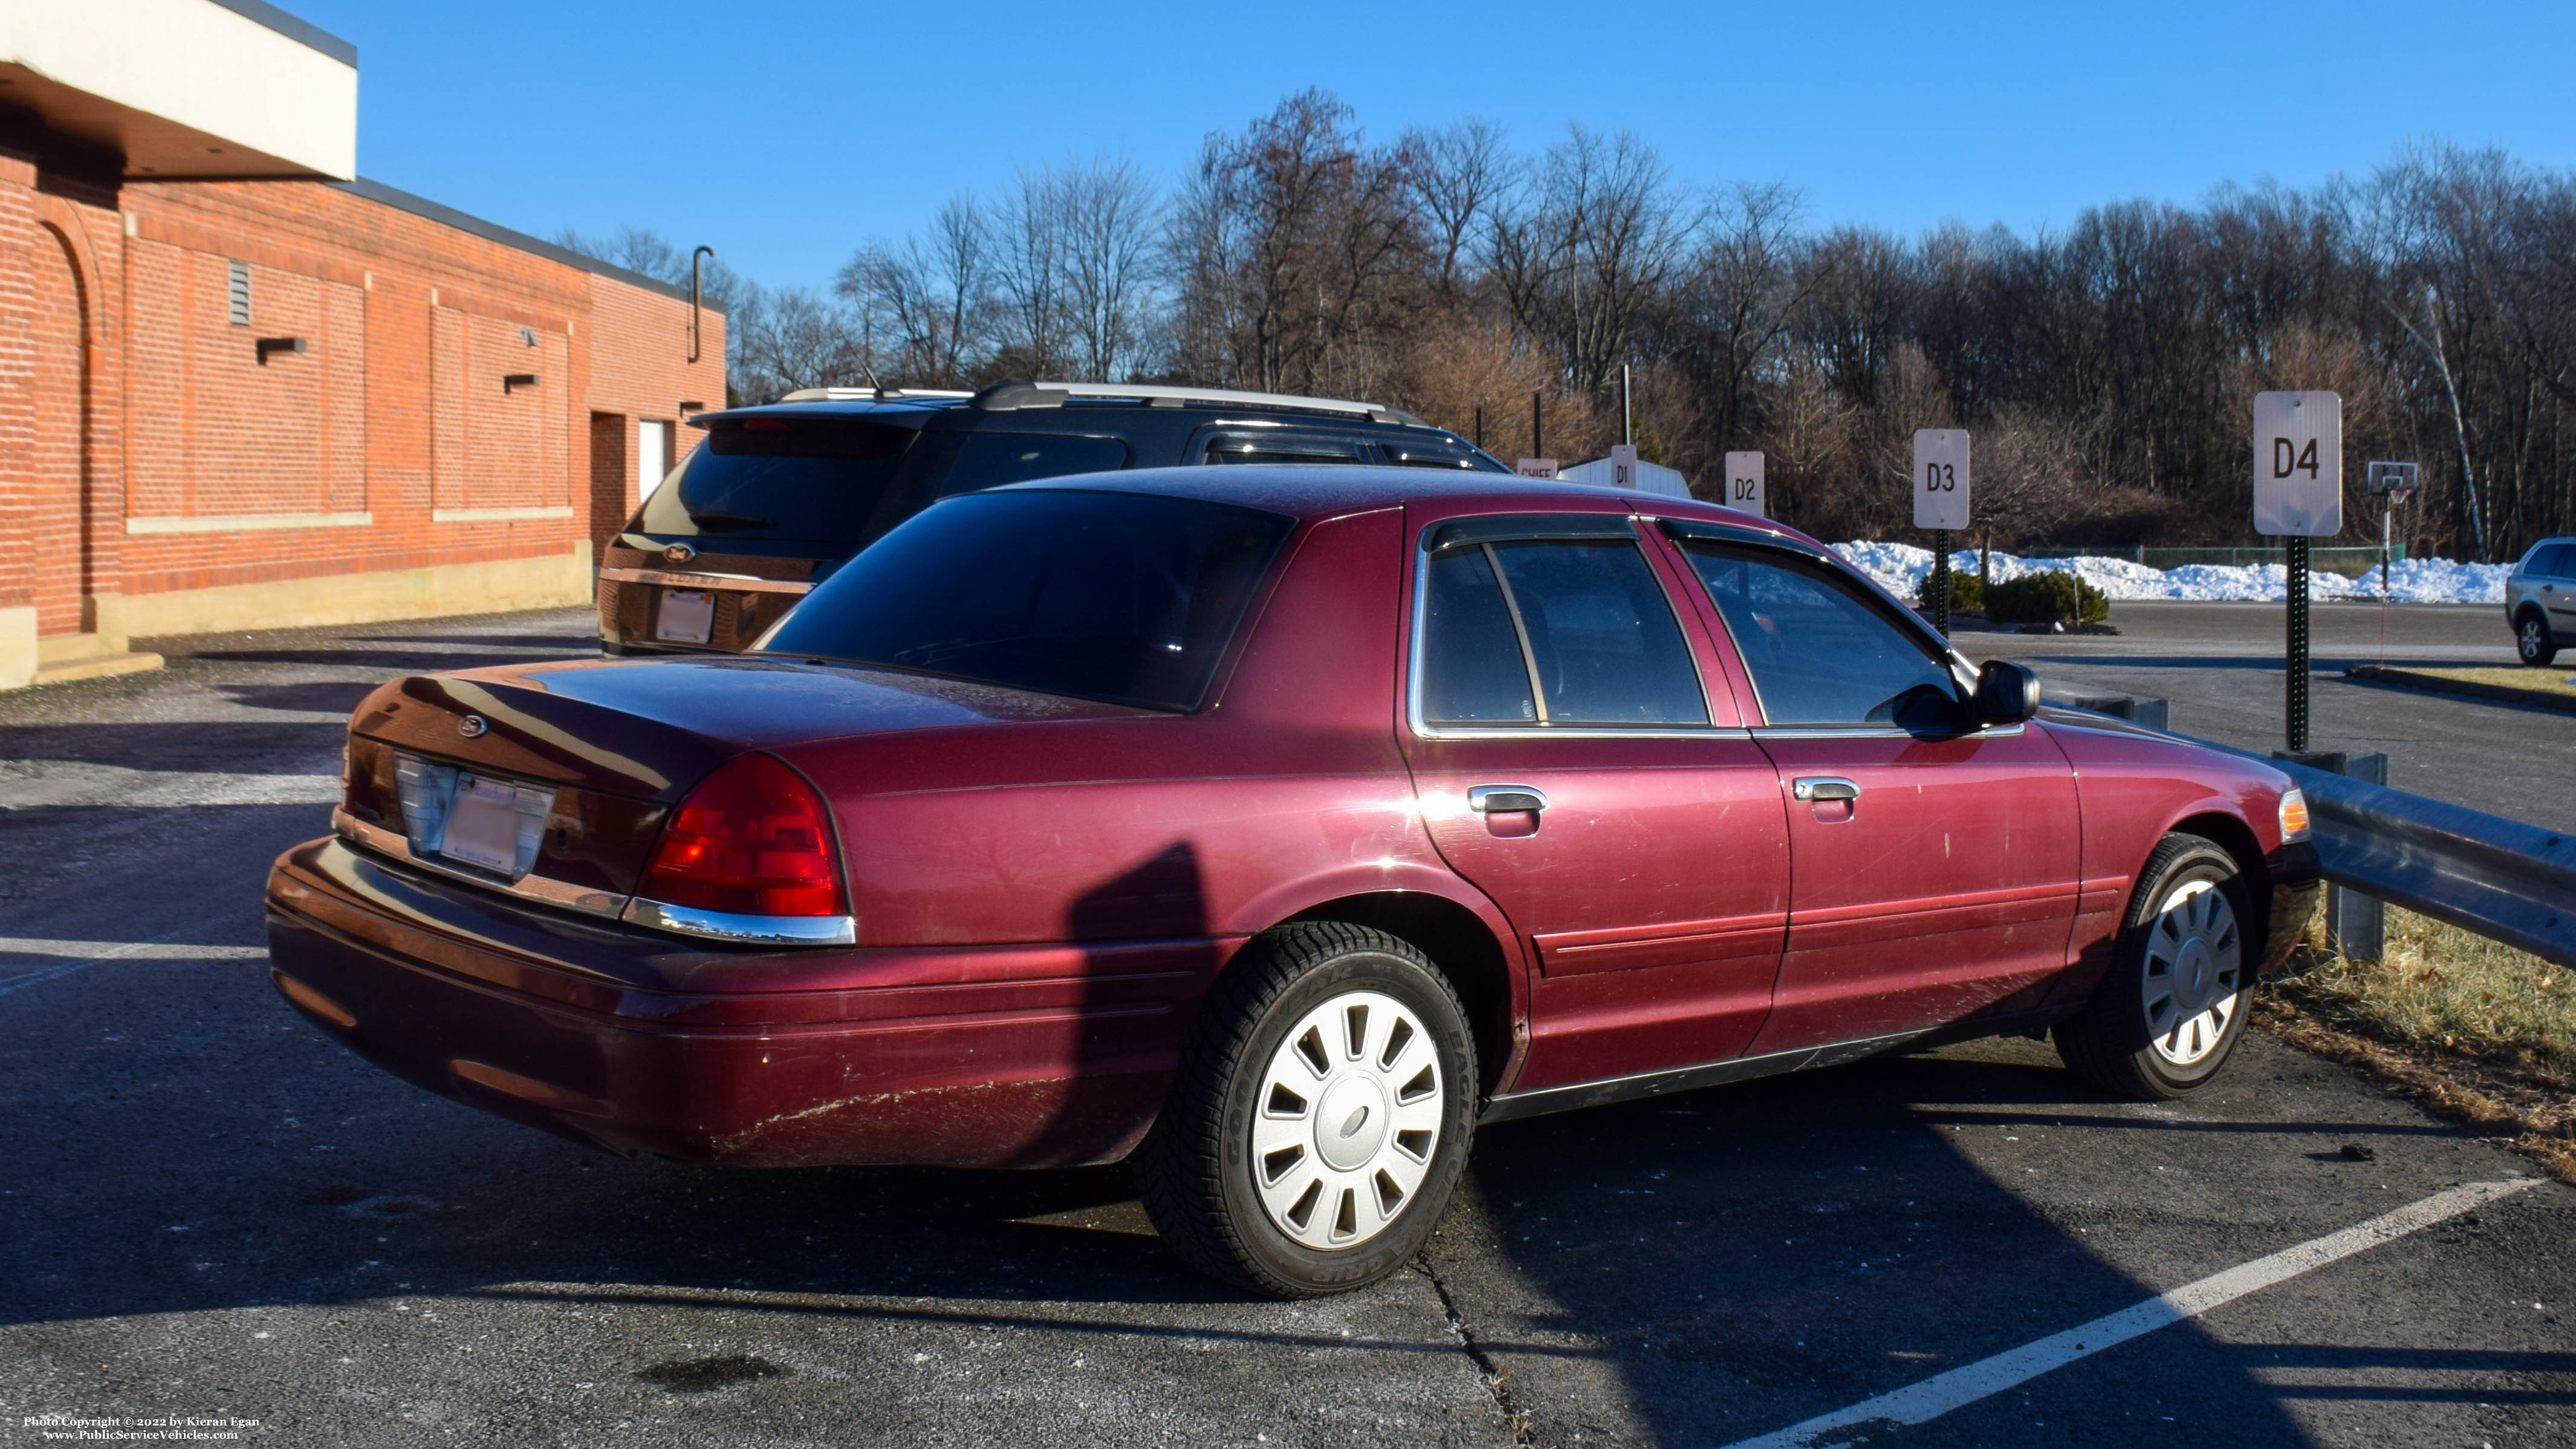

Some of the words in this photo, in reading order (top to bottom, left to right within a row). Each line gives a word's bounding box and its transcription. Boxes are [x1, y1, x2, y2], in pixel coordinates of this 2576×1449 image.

[2274, 437, 2319, 479] D4
[1520, 467, 1551, 478] CHIEF
[1617, 465, 1627, 483] D1
[1927, 462, 1955, 492] D3
[1735, 478, 1755, 501] D2
[1449, 1029, 1470, 1147] EAGLE
